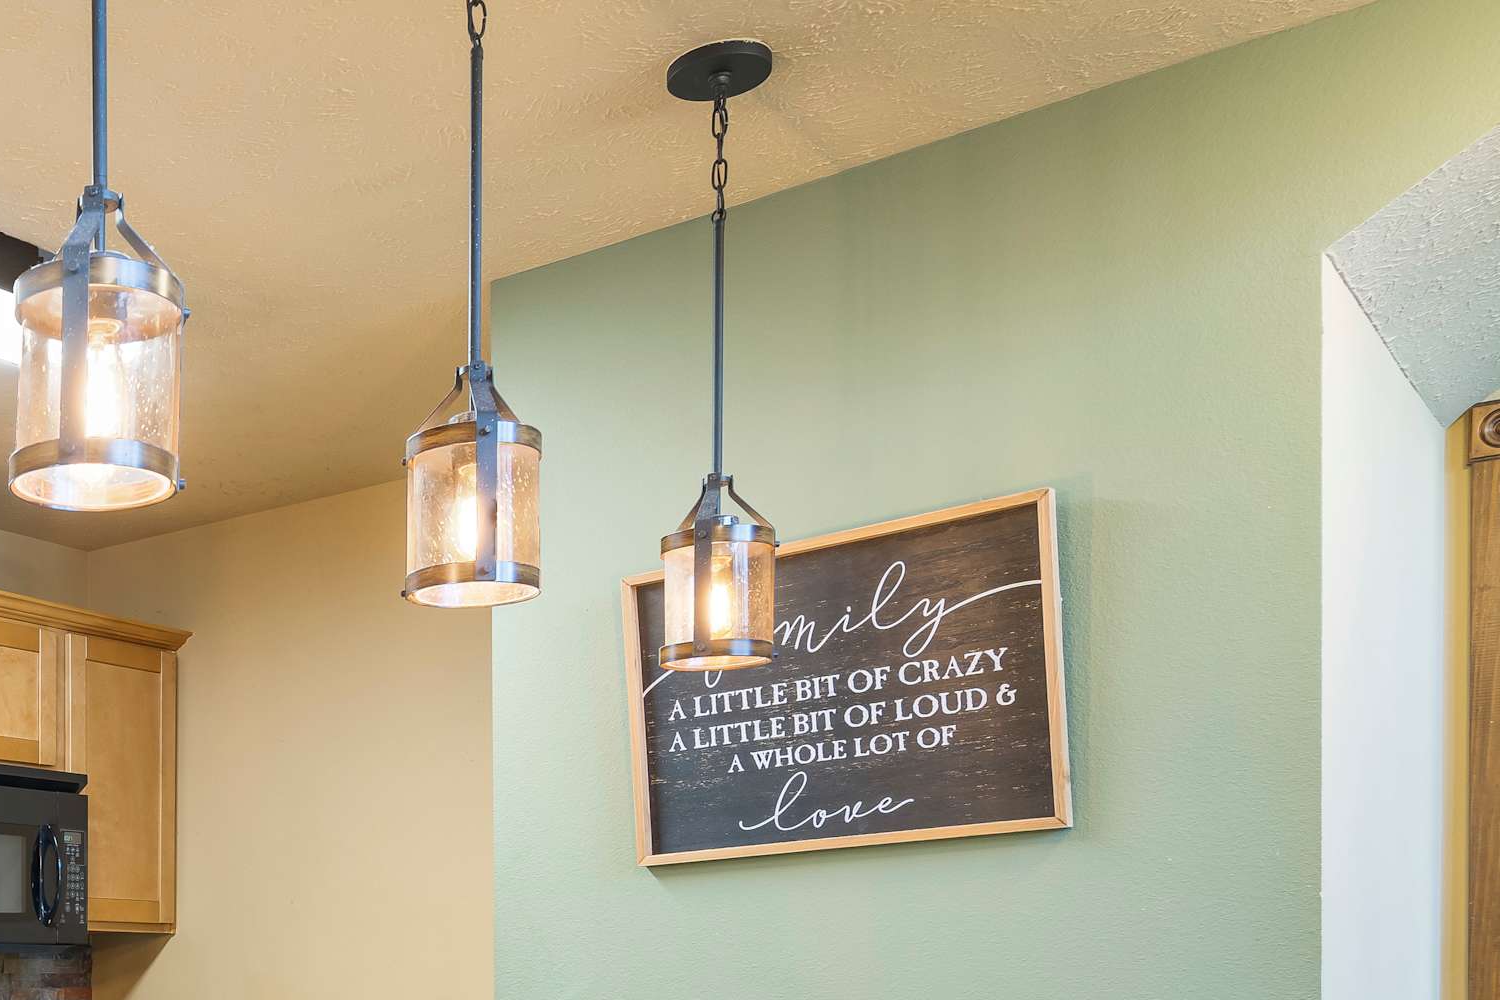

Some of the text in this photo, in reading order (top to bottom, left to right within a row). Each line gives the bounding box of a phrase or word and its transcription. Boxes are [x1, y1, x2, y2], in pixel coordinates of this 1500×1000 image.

[668, 647, 1009, 721] A LITTLE BIT OF CRAZY
[668, 683, 1018, 752] A LITTLE BIT OF LOUD &
[727, 724, 957, 773] A WHOLE LOT OF
[738, 771, 915, 831] love
